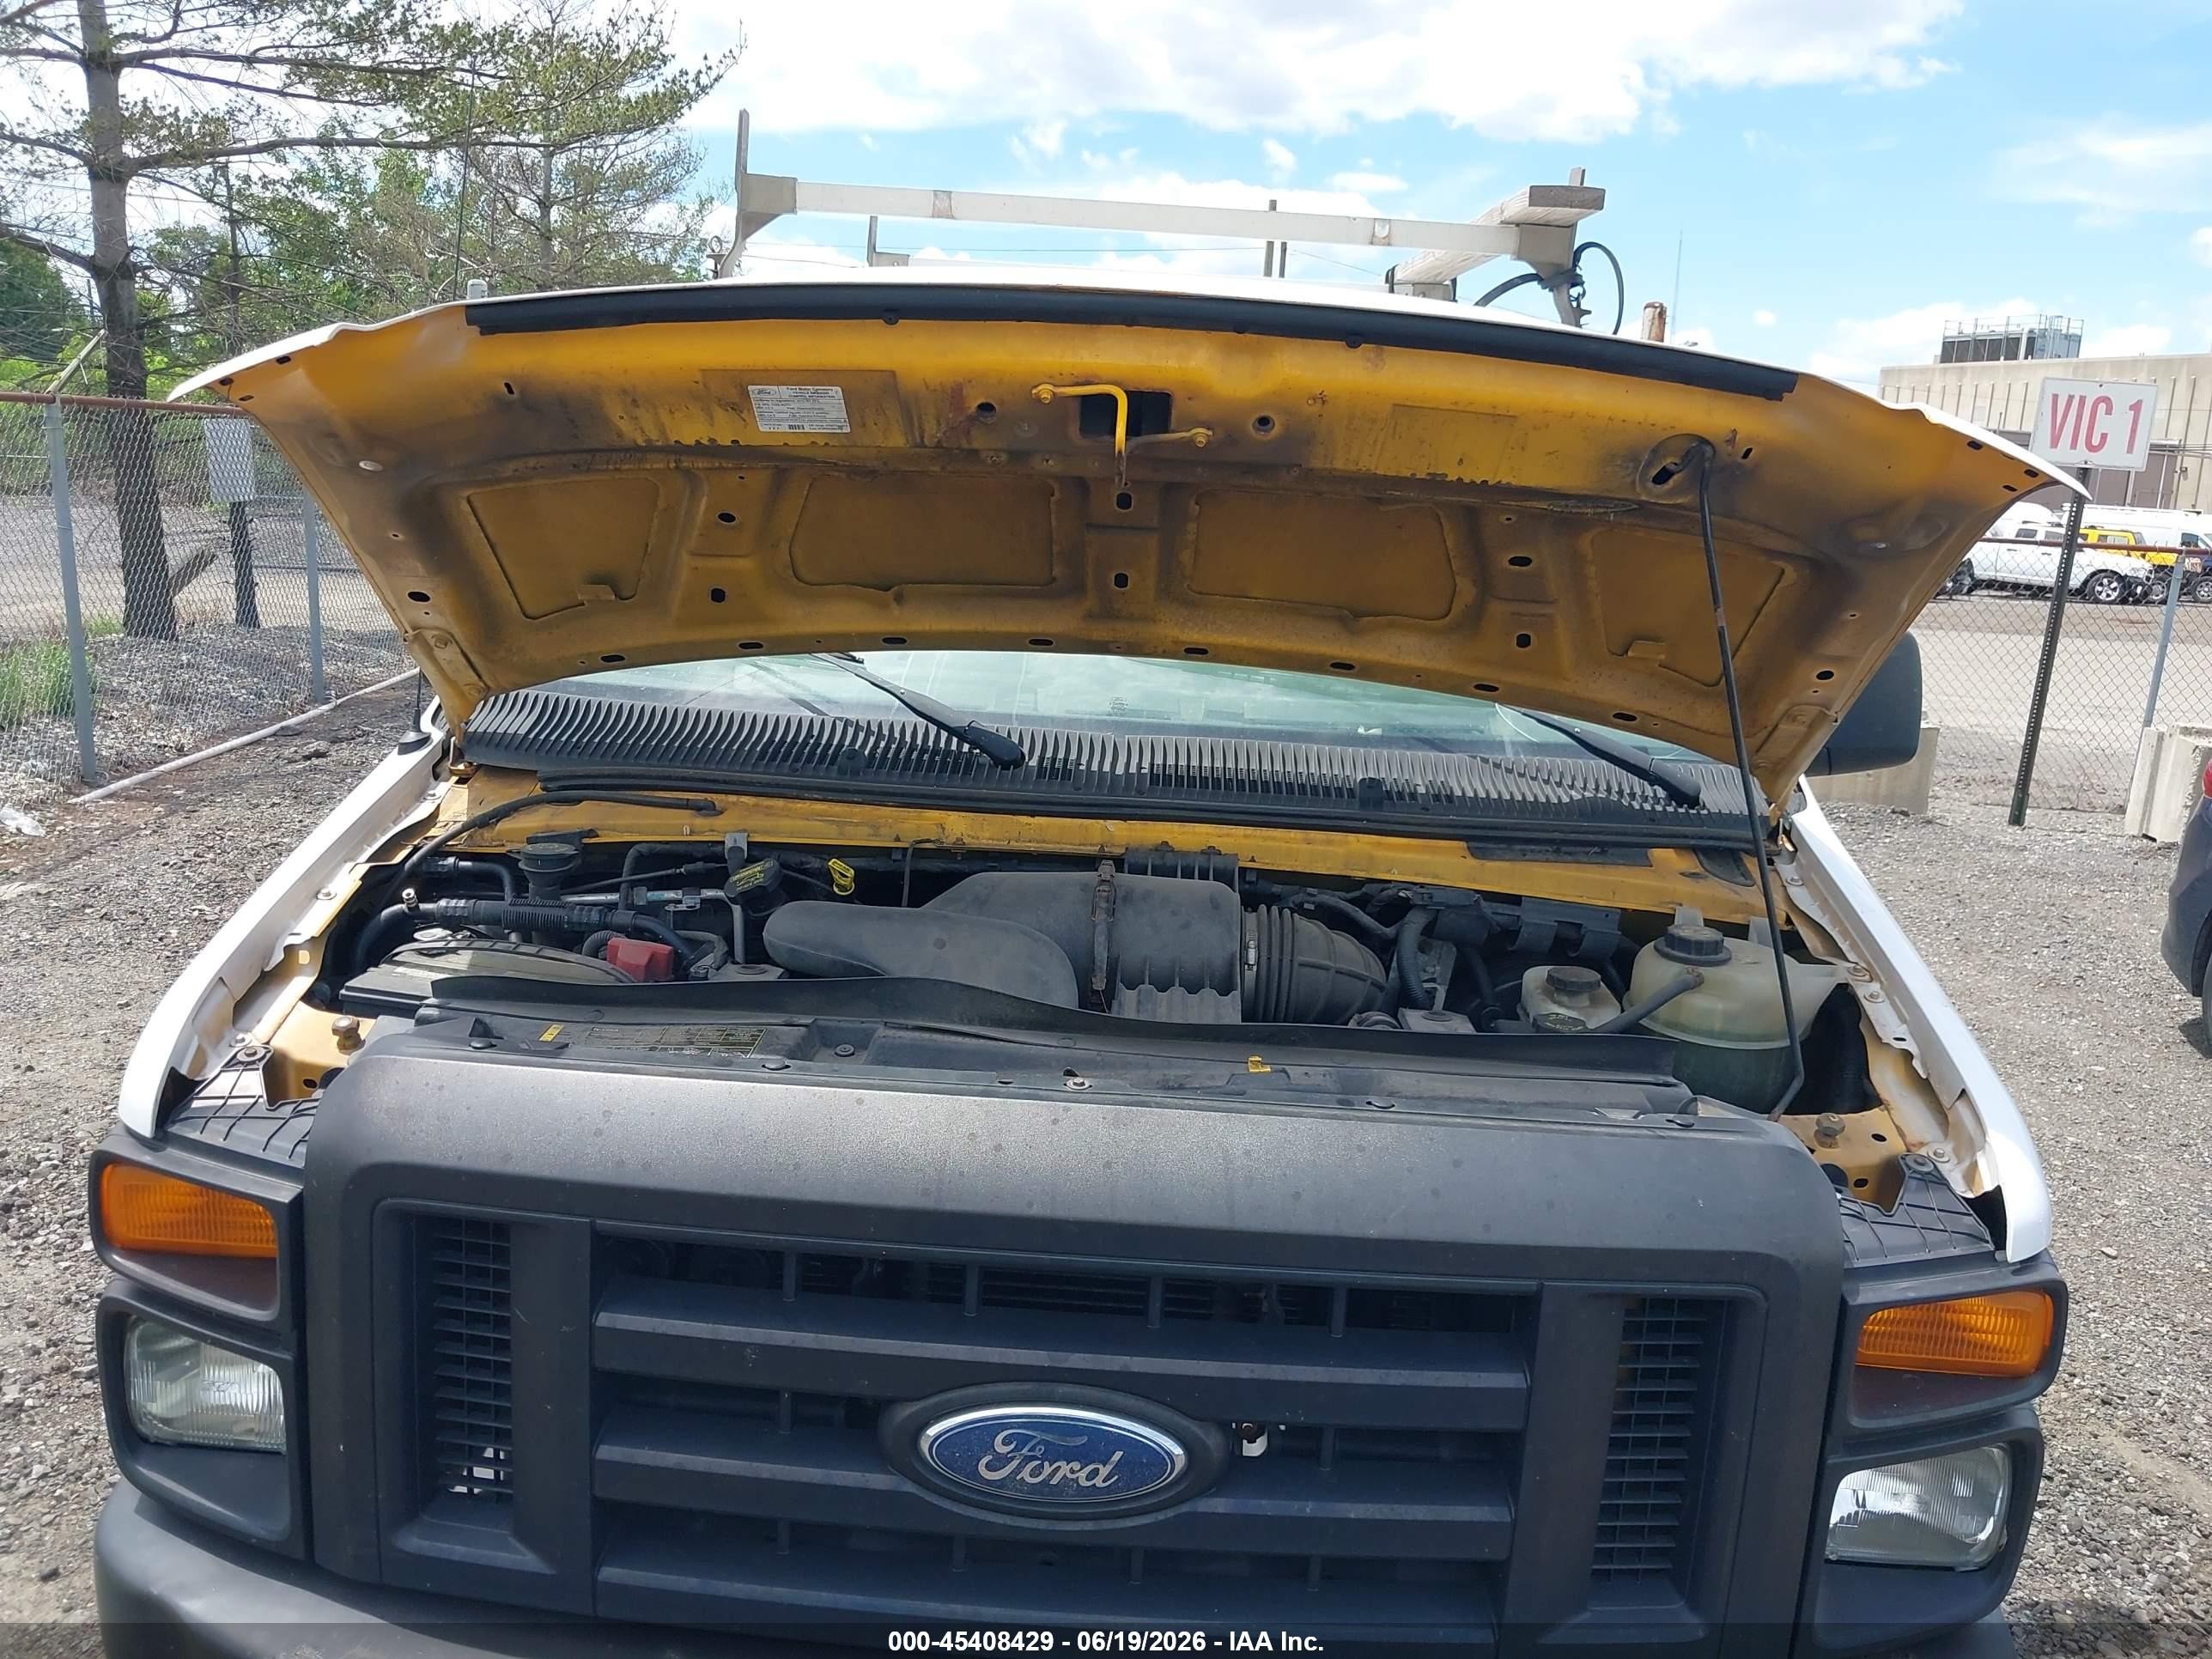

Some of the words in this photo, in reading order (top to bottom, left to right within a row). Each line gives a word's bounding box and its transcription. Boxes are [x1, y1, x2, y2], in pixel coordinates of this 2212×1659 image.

[2049, 392, 2114, 453] VIC
[2124, 398, 2143, 454] 1
[977, 1428, 1124, 1488] Ford
